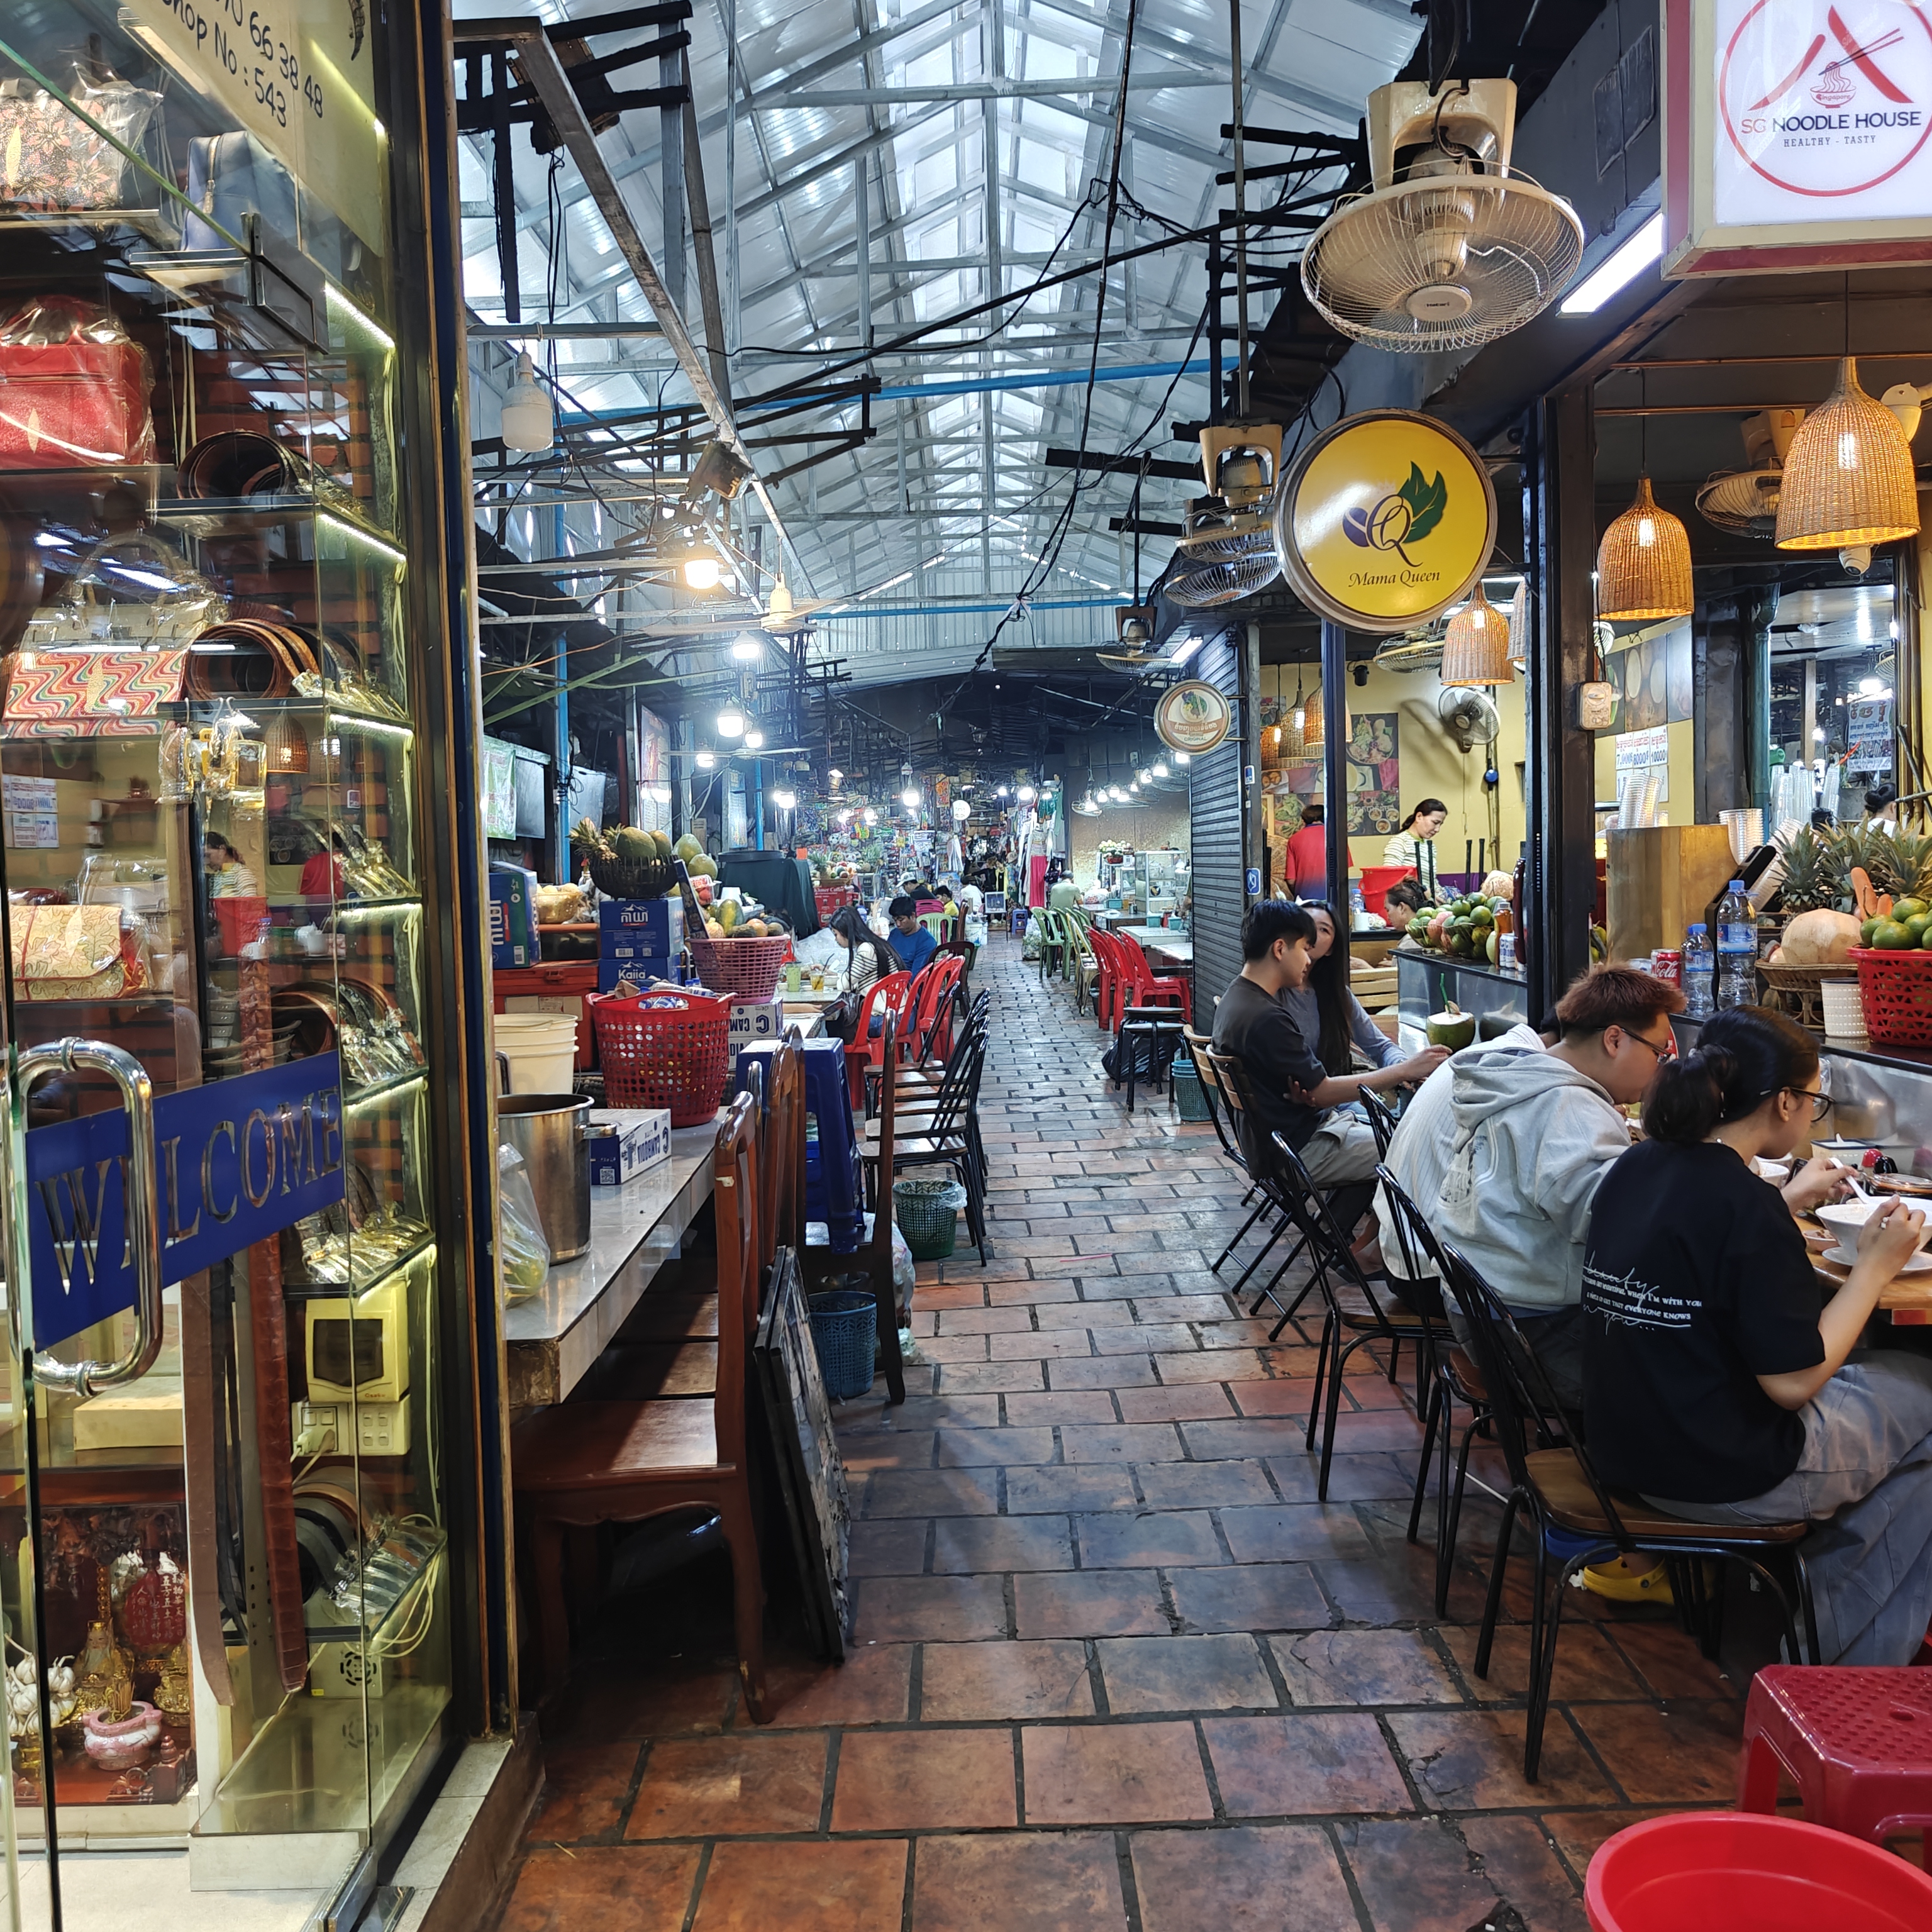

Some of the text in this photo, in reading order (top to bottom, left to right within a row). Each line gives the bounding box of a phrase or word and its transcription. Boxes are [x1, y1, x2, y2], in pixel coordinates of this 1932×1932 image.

[162, 0, 208, 51] hop
[215, 21, 237, 75] No
[255, 67, 286, 128] 543
[250, 11, 323, 118] 66 38 48
[1741, 111, 1921, 133] SG NOODLE HOUSE
[1784, 136, 1831, 147] HEALTHY
[1844, 135, 1876, 145] TASTY
[1348, 569, 1440, 588] Mama Queen
[618, 969, 646, 979] Kaiia
[35, 1085, 342, 1296] WLCOME
[1662, 1311, 1692, 1319] KNOWS
